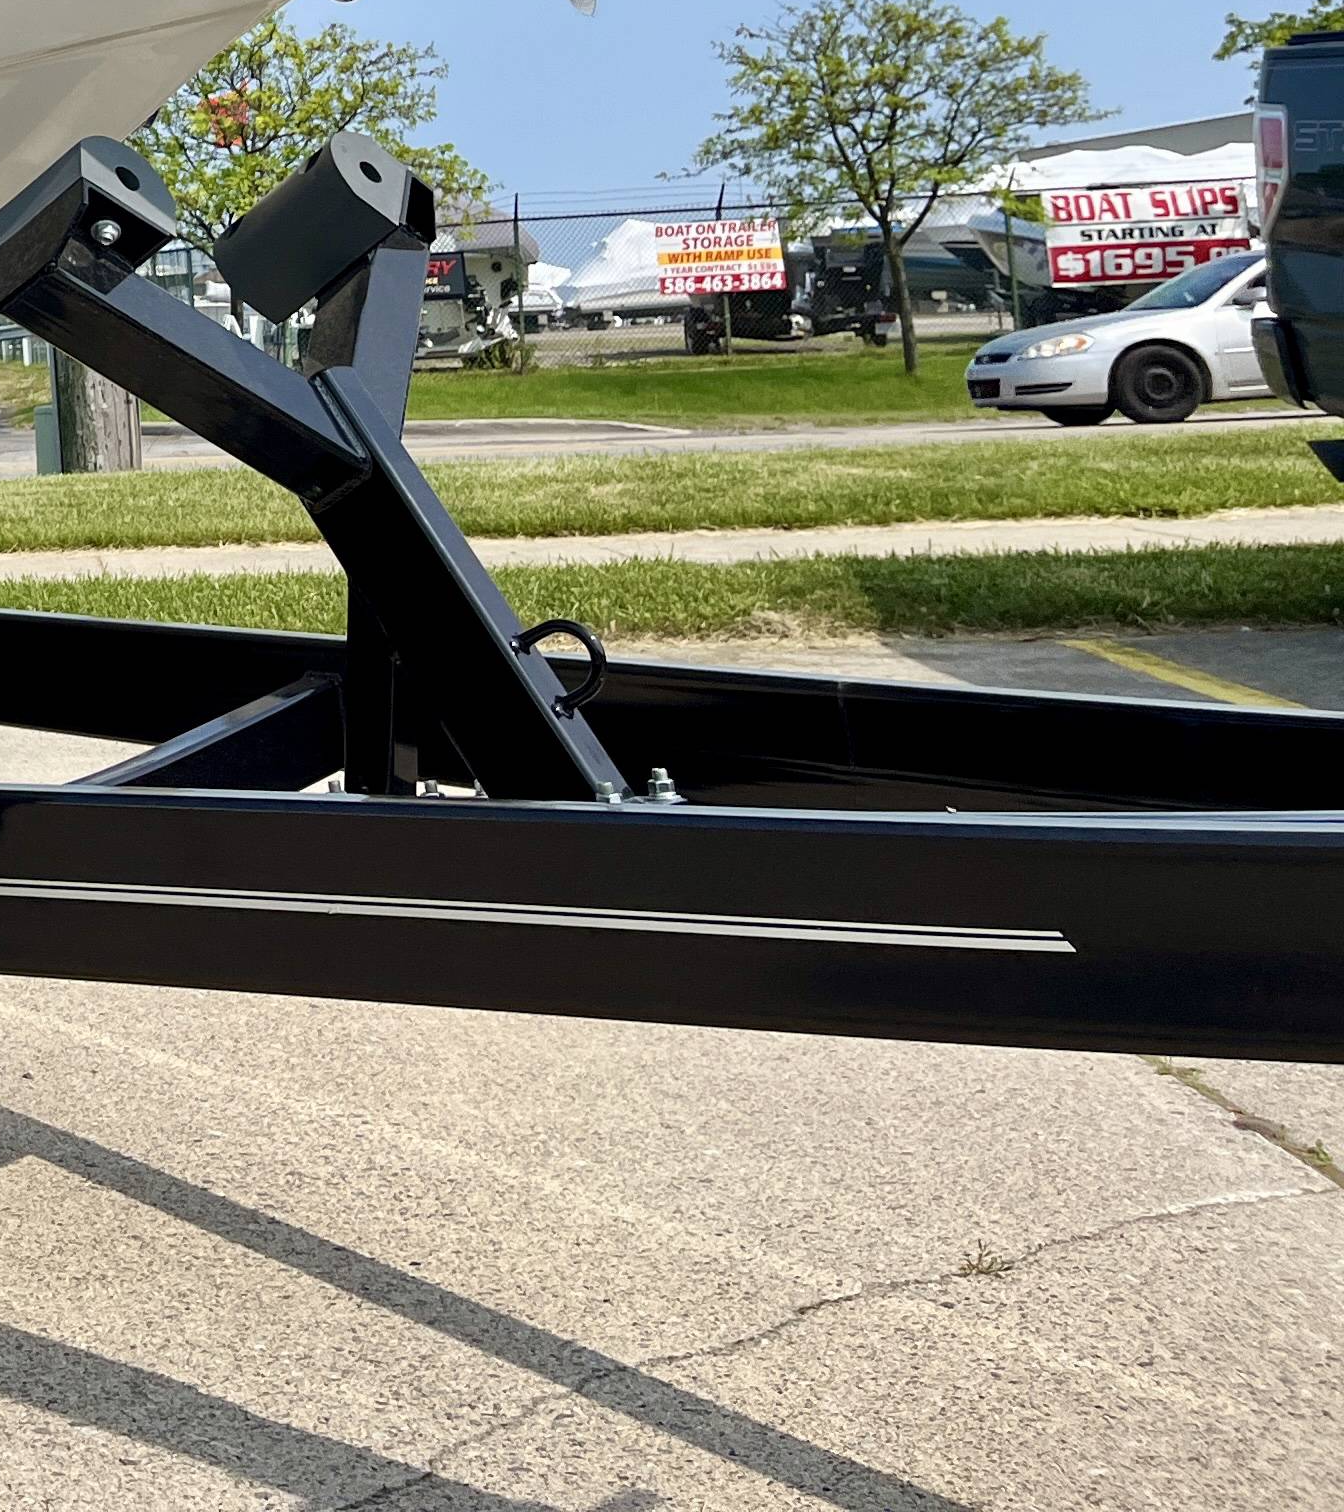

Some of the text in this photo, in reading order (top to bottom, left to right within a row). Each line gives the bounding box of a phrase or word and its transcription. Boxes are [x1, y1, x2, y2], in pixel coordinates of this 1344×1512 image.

[1050, 185, 1239, 223] BOAT SLIPS
[655, 220, 777, 238] BOAT ON TRAILER
[1080, 223, 1218, 242] STARTING AT
[682, 235, 754, 250] STORAGE
[667, 248, 772, 265] WITH RAMP USE
[695, 263, 742, 273] CONTRACT
[664, 272, 783, 294] 586-463-3864
